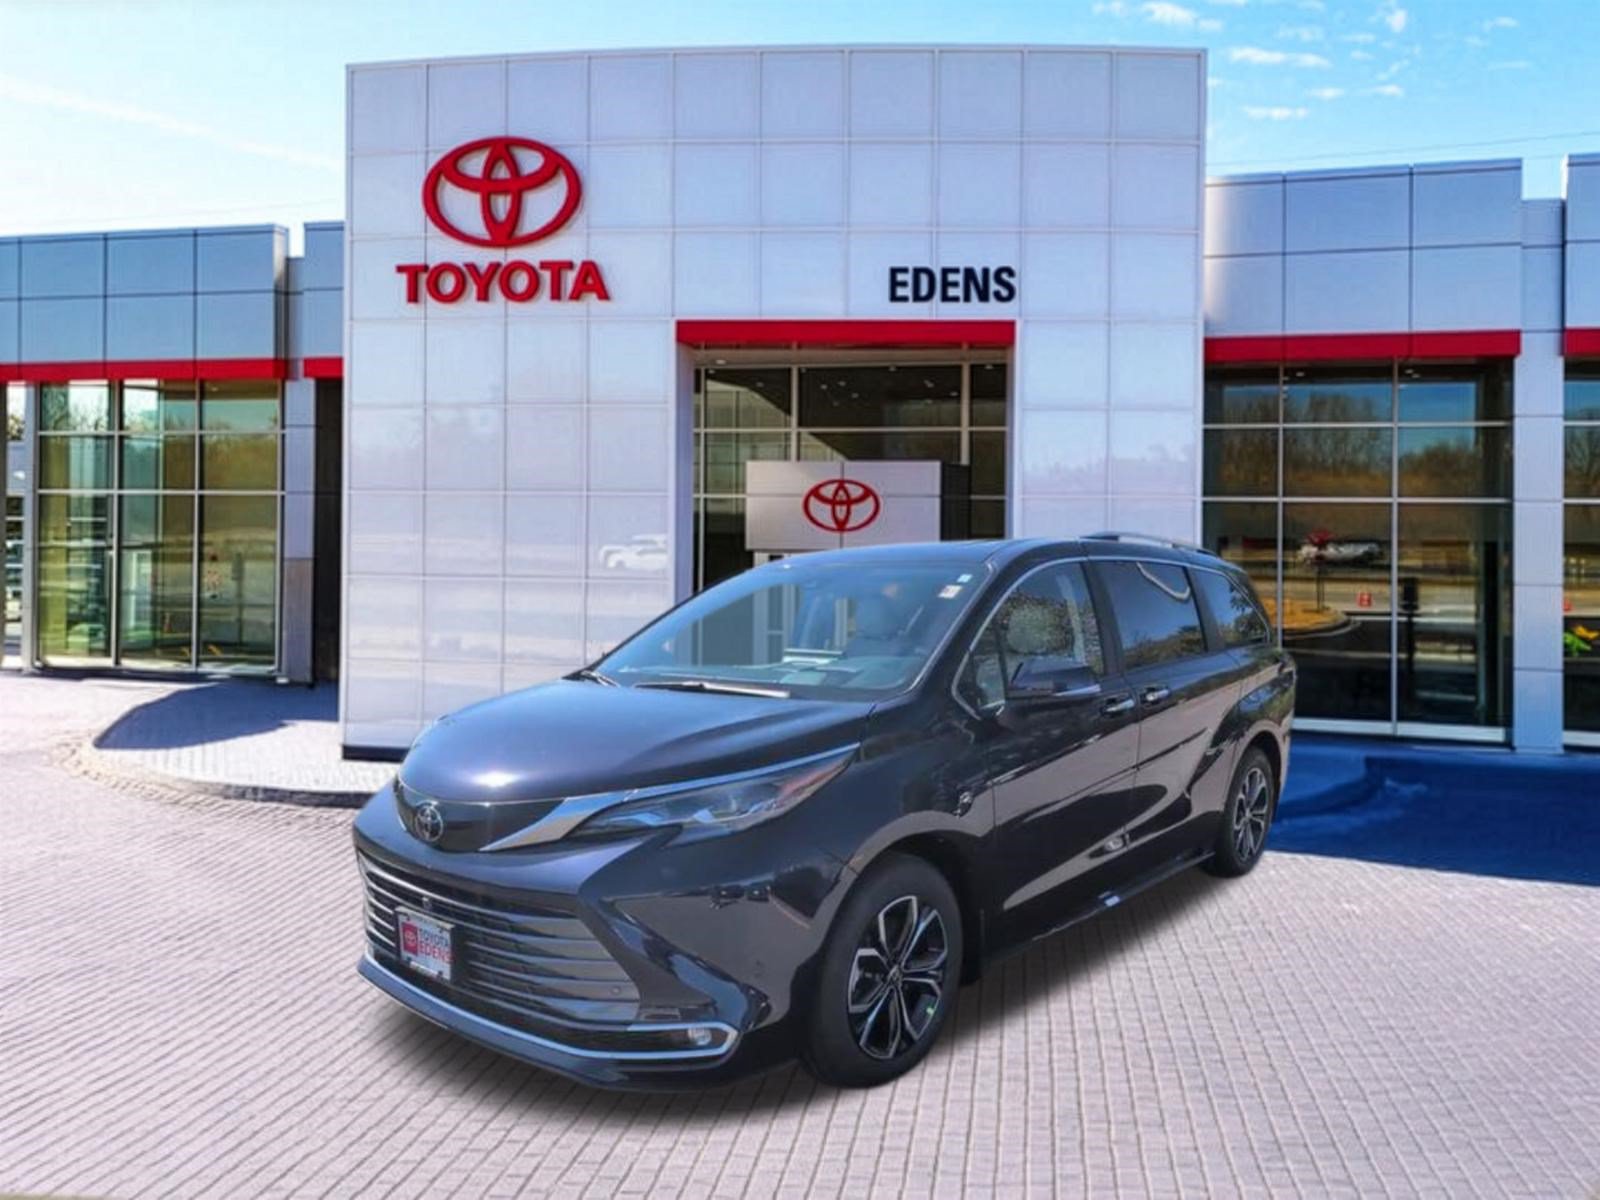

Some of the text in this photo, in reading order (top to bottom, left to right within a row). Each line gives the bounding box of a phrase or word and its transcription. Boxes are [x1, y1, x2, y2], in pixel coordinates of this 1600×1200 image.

[396, 260, 610, 304] TOYOTA
[889, 266, 1016, 303] EDENS
[419, 927, 450, 948] TOYOTA
[419, 940, 451, 964] EDENS
